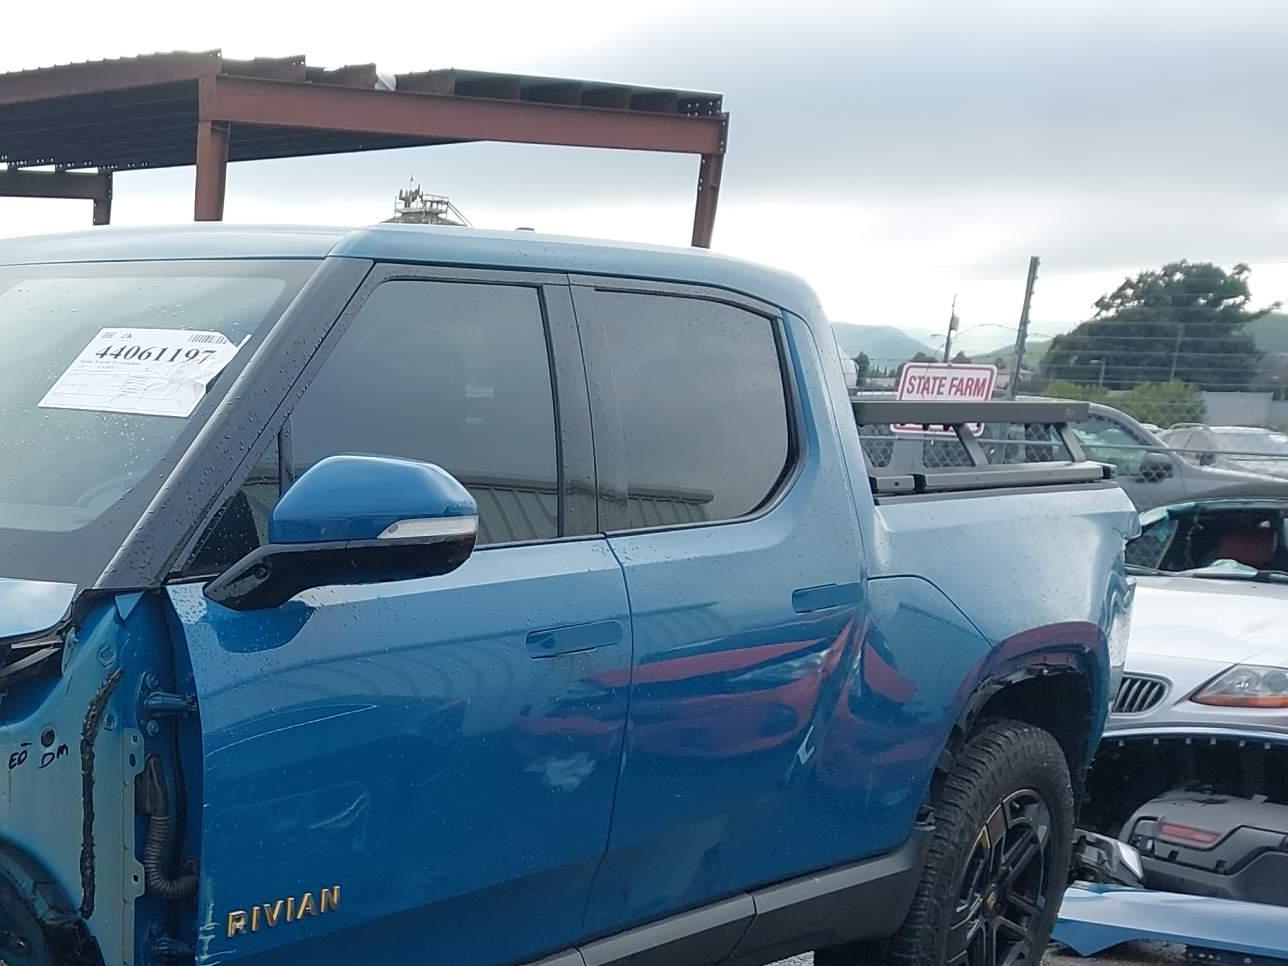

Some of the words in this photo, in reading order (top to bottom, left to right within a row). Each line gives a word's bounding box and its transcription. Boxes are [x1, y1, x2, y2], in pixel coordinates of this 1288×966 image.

[95, 344, 217, 365] 44061197
[906, 375, 948, 396] STATE
[948, 376, 987, 398] FARM
[227, 885, 341, 938] RIVIAN
